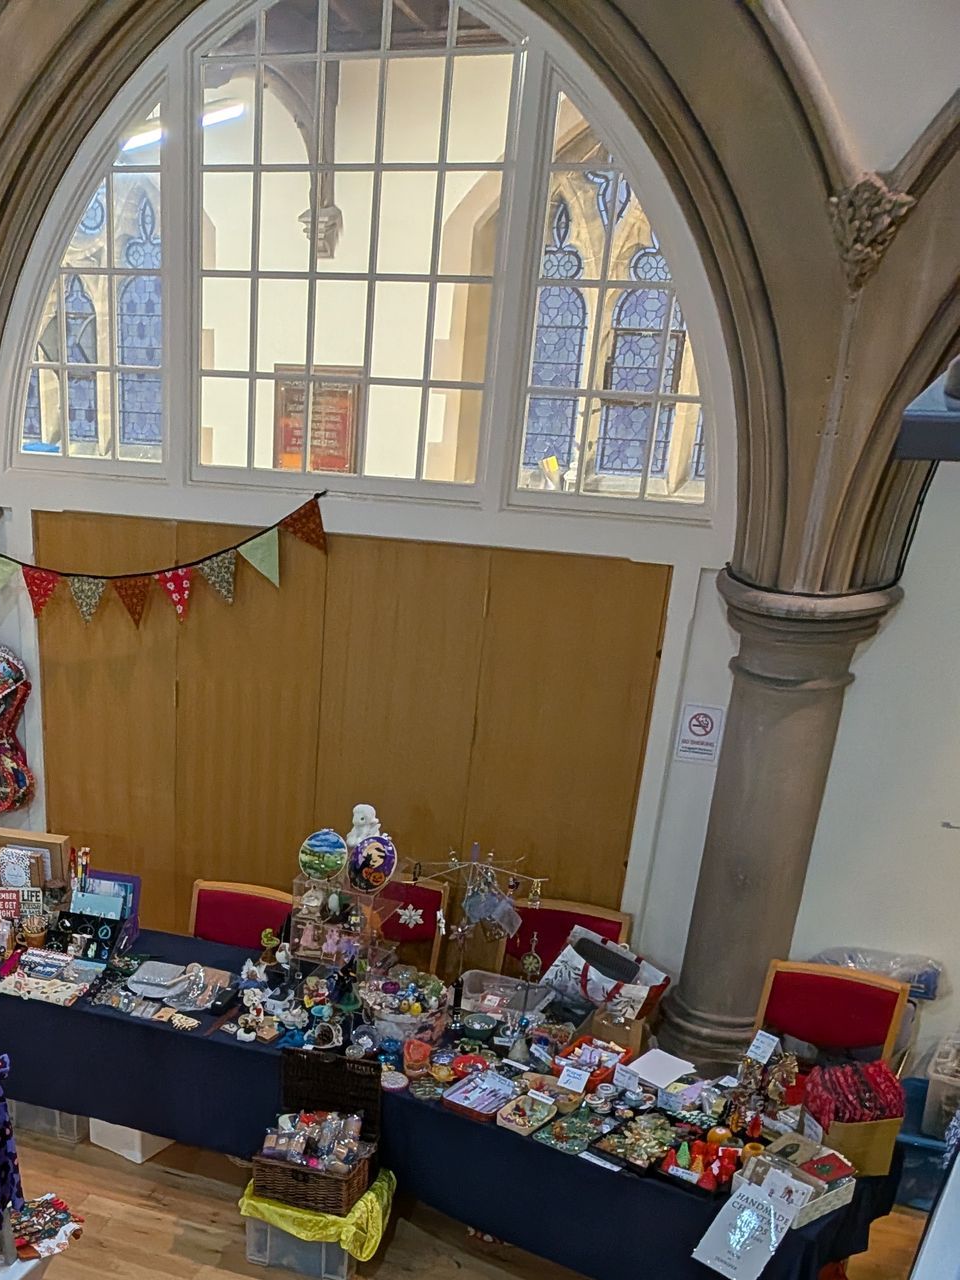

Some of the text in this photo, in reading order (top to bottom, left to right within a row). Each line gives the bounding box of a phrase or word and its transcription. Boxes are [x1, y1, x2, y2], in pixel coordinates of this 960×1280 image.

[22, 890, 41, 901] LIFE
[4, 902, 17, 910] GET
[736, 1192, 790, 1226] HANDMADE
